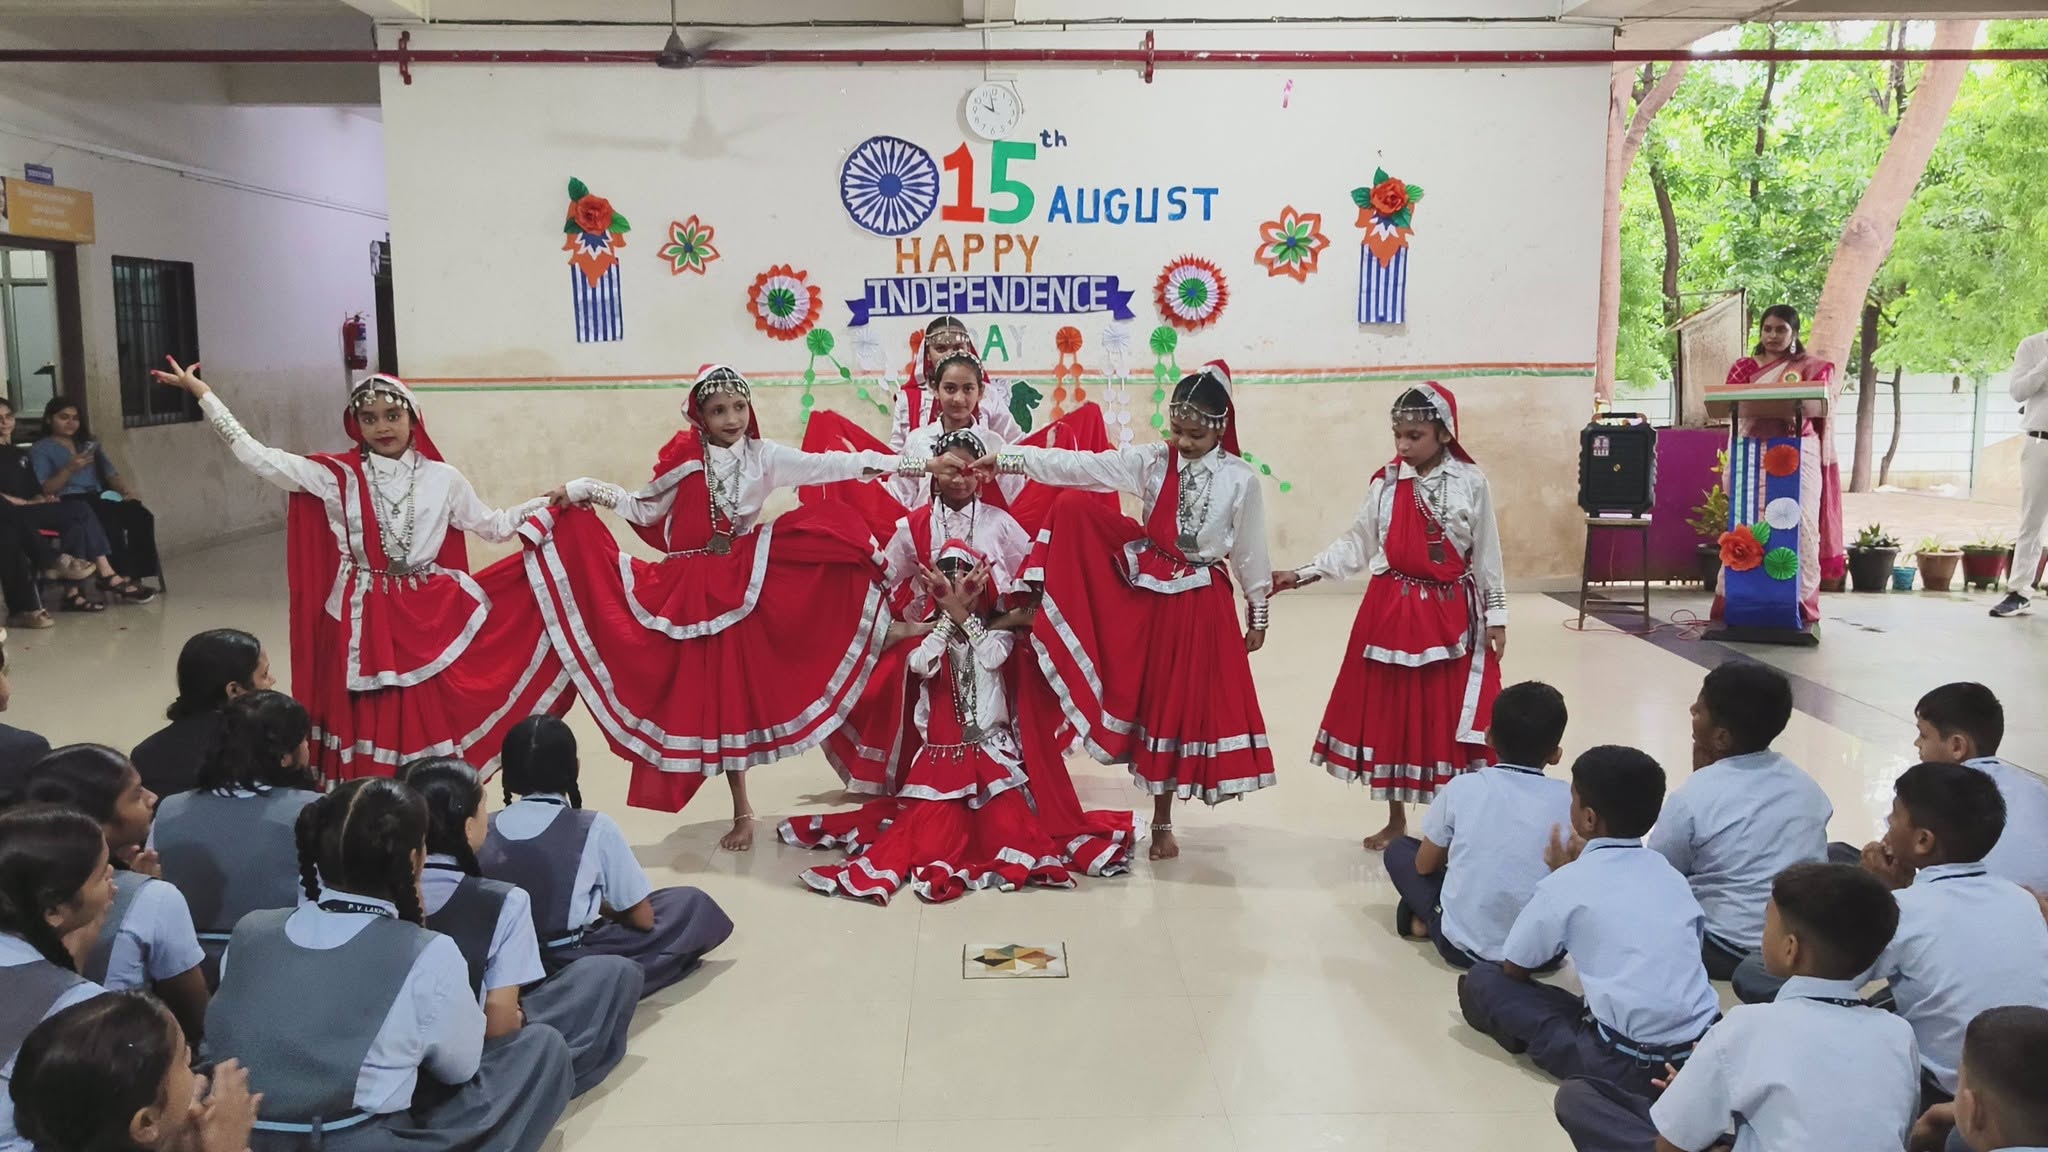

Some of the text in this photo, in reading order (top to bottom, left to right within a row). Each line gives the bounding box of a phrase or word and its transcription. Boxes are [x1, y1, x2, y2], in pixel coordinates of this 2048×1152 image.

[1048, 185, 1219, 224] AUGUST
[895, 233, 1039, 274] HAPPY
[867, 276, 1108, 314] INDEPENDENCE
